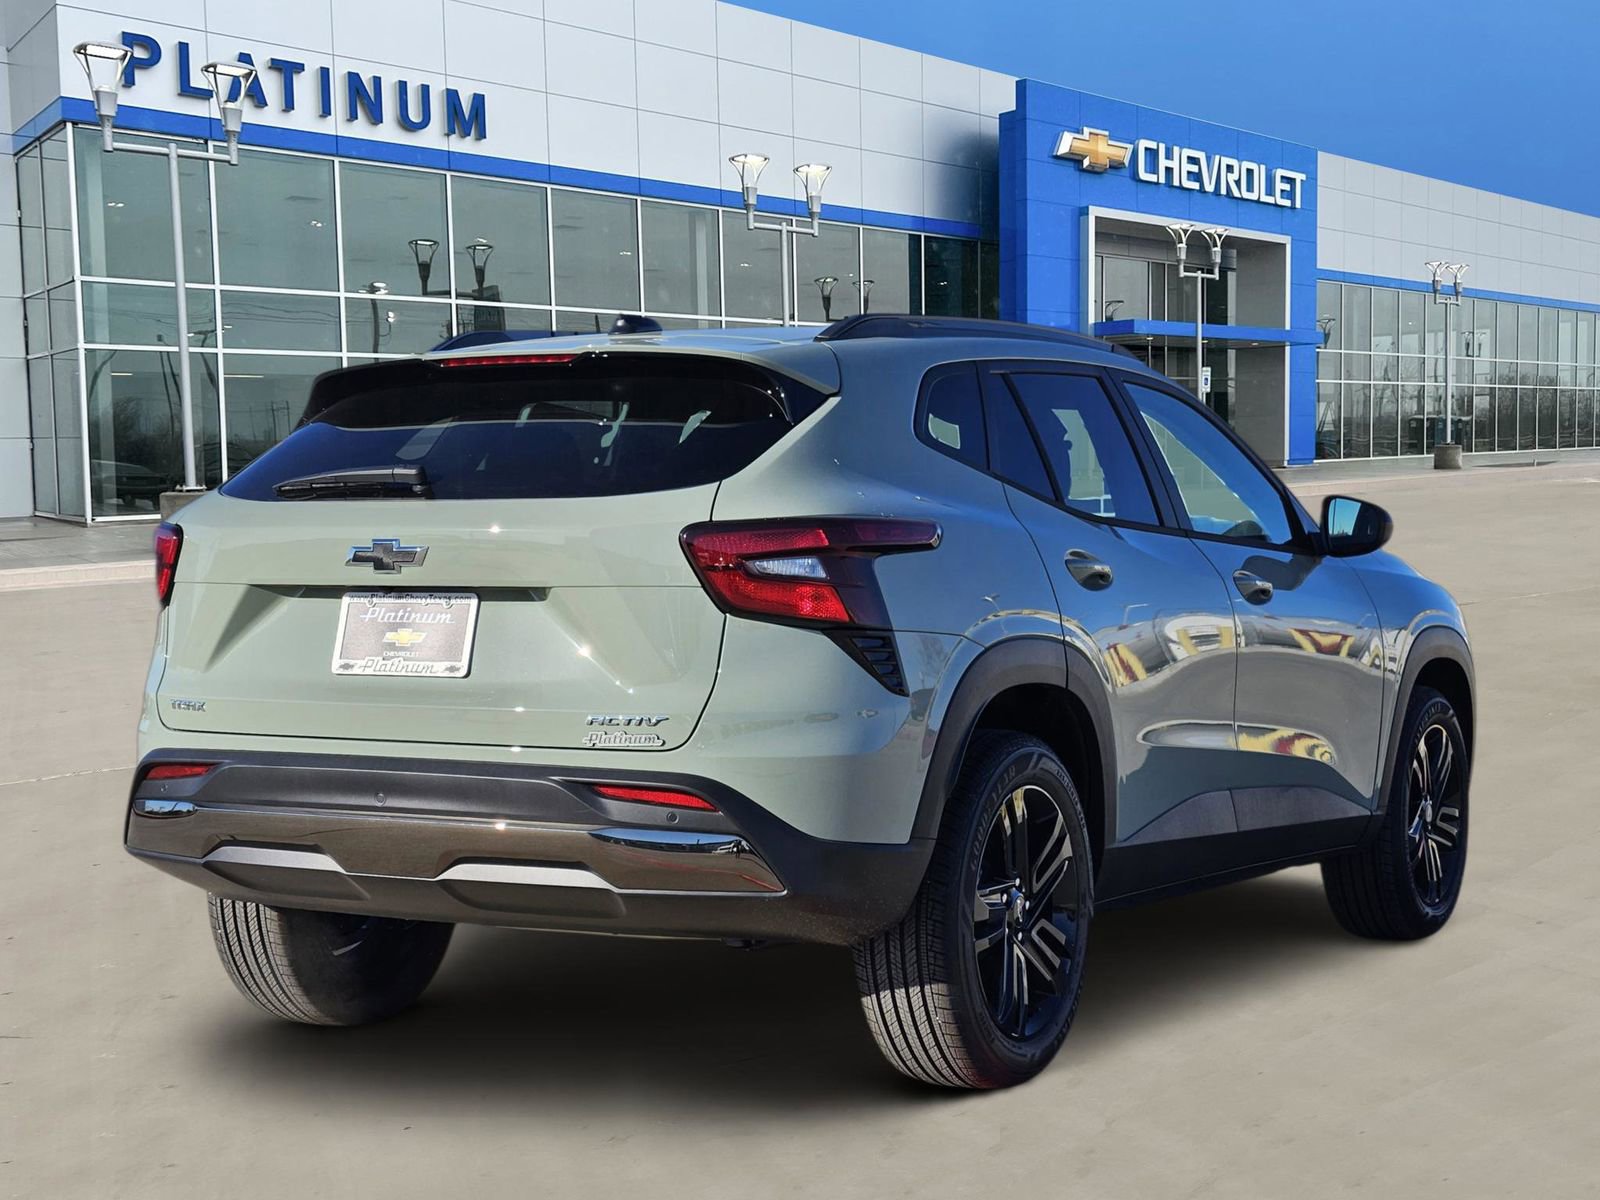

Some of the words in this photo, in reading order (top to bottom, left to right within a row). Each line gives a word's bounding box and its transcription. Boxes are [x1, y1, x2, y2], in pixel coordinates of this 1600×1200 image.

[122, 31, 487, 140] PLATINUM
[1136, 139, 1306, 209] CHEVROLET
[360, 607, 456, 624] Platinum
[359, 658, 439, 674] Platinum
[586, 714, 669, 727] ACTIV
[583, 731, 666, 747] Platinum
